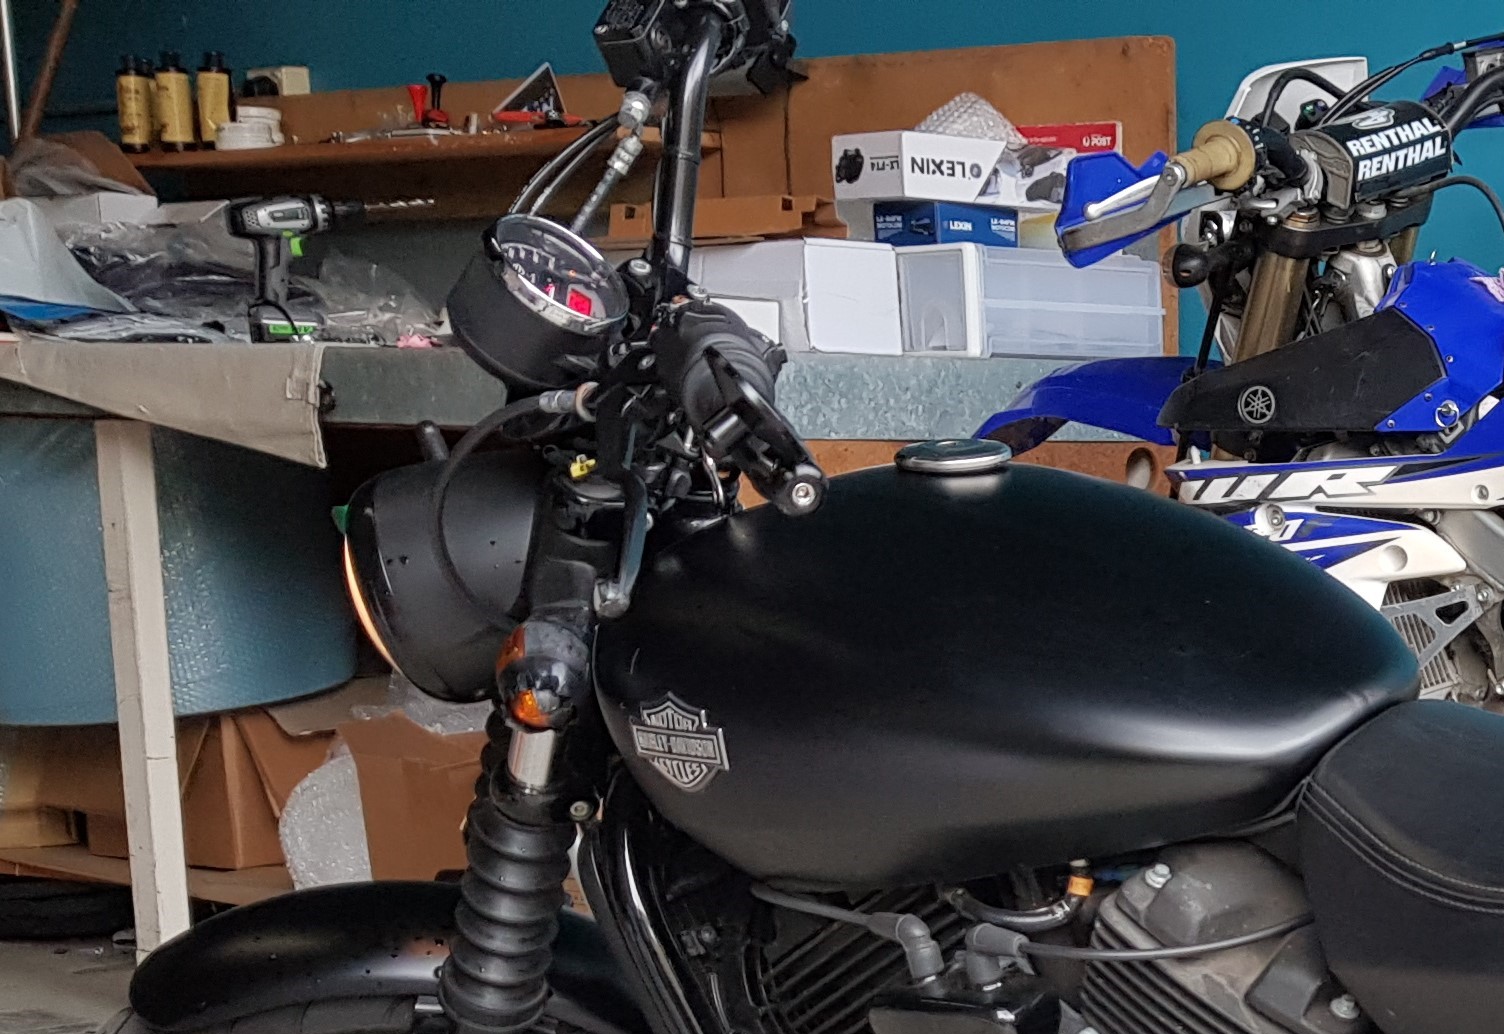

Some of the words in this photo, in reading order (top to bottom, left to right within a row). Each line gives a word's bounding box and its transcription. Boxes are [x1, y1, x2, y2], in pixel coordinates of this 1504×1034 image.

[1091, 136, 1112, 147] POST
[1346, 117, 1442, 157] RENTHAL
[910, 156, 966, 178] LEXIN
[1357, 136, 1446, 181] RENTHAL
[650, 708, 694, 732] MOTOR
